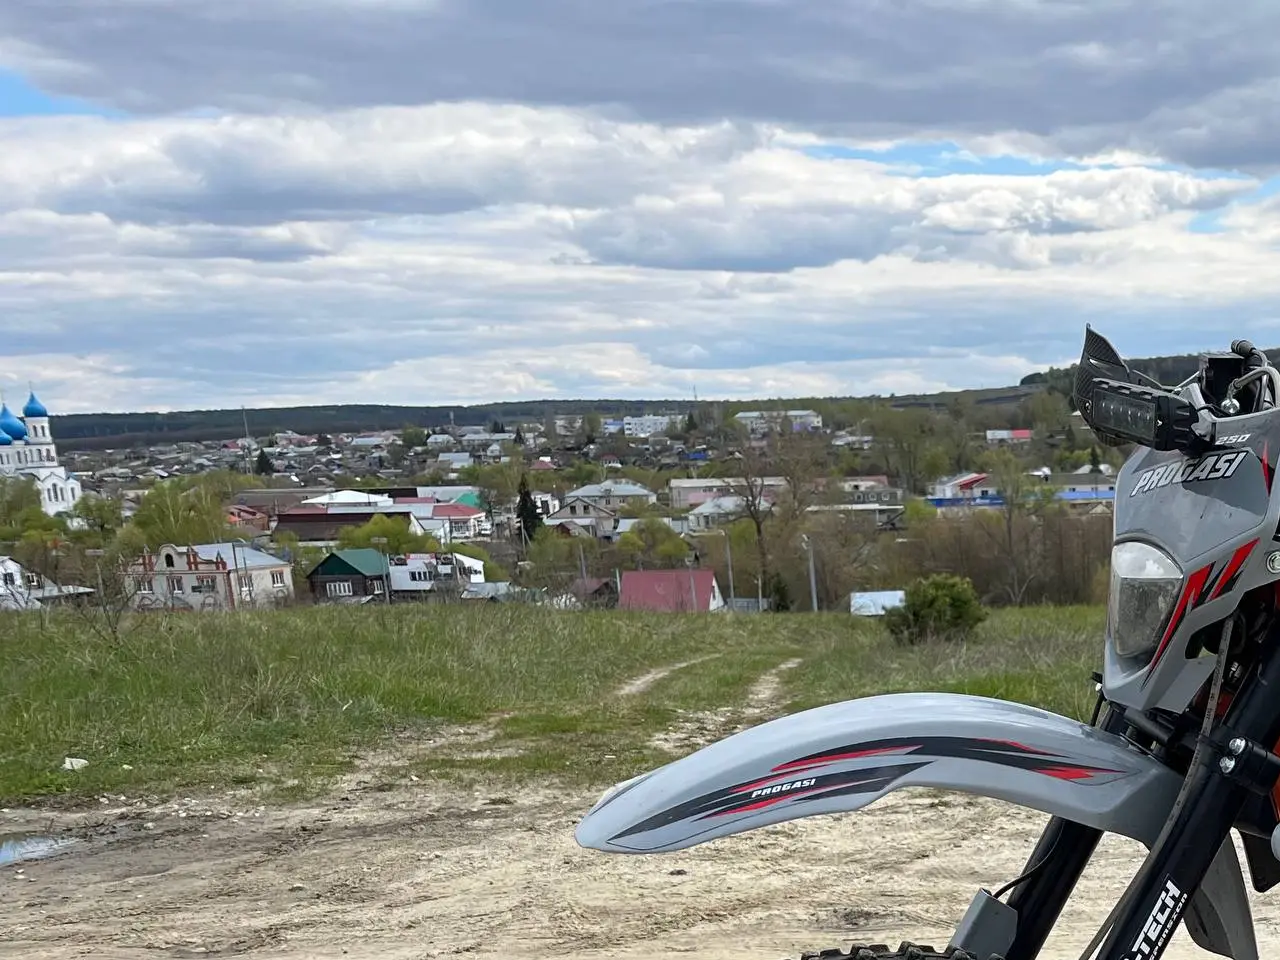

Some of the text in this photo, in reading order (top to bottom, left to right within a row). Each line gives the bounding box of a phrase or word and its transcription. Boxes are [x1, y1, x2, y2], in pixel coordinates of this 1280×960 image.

[1215, 434, 1251, 446] 250
[1130, 452, 1248, 497] PROGASI
[751, 779, 816, 798] PROGASI
